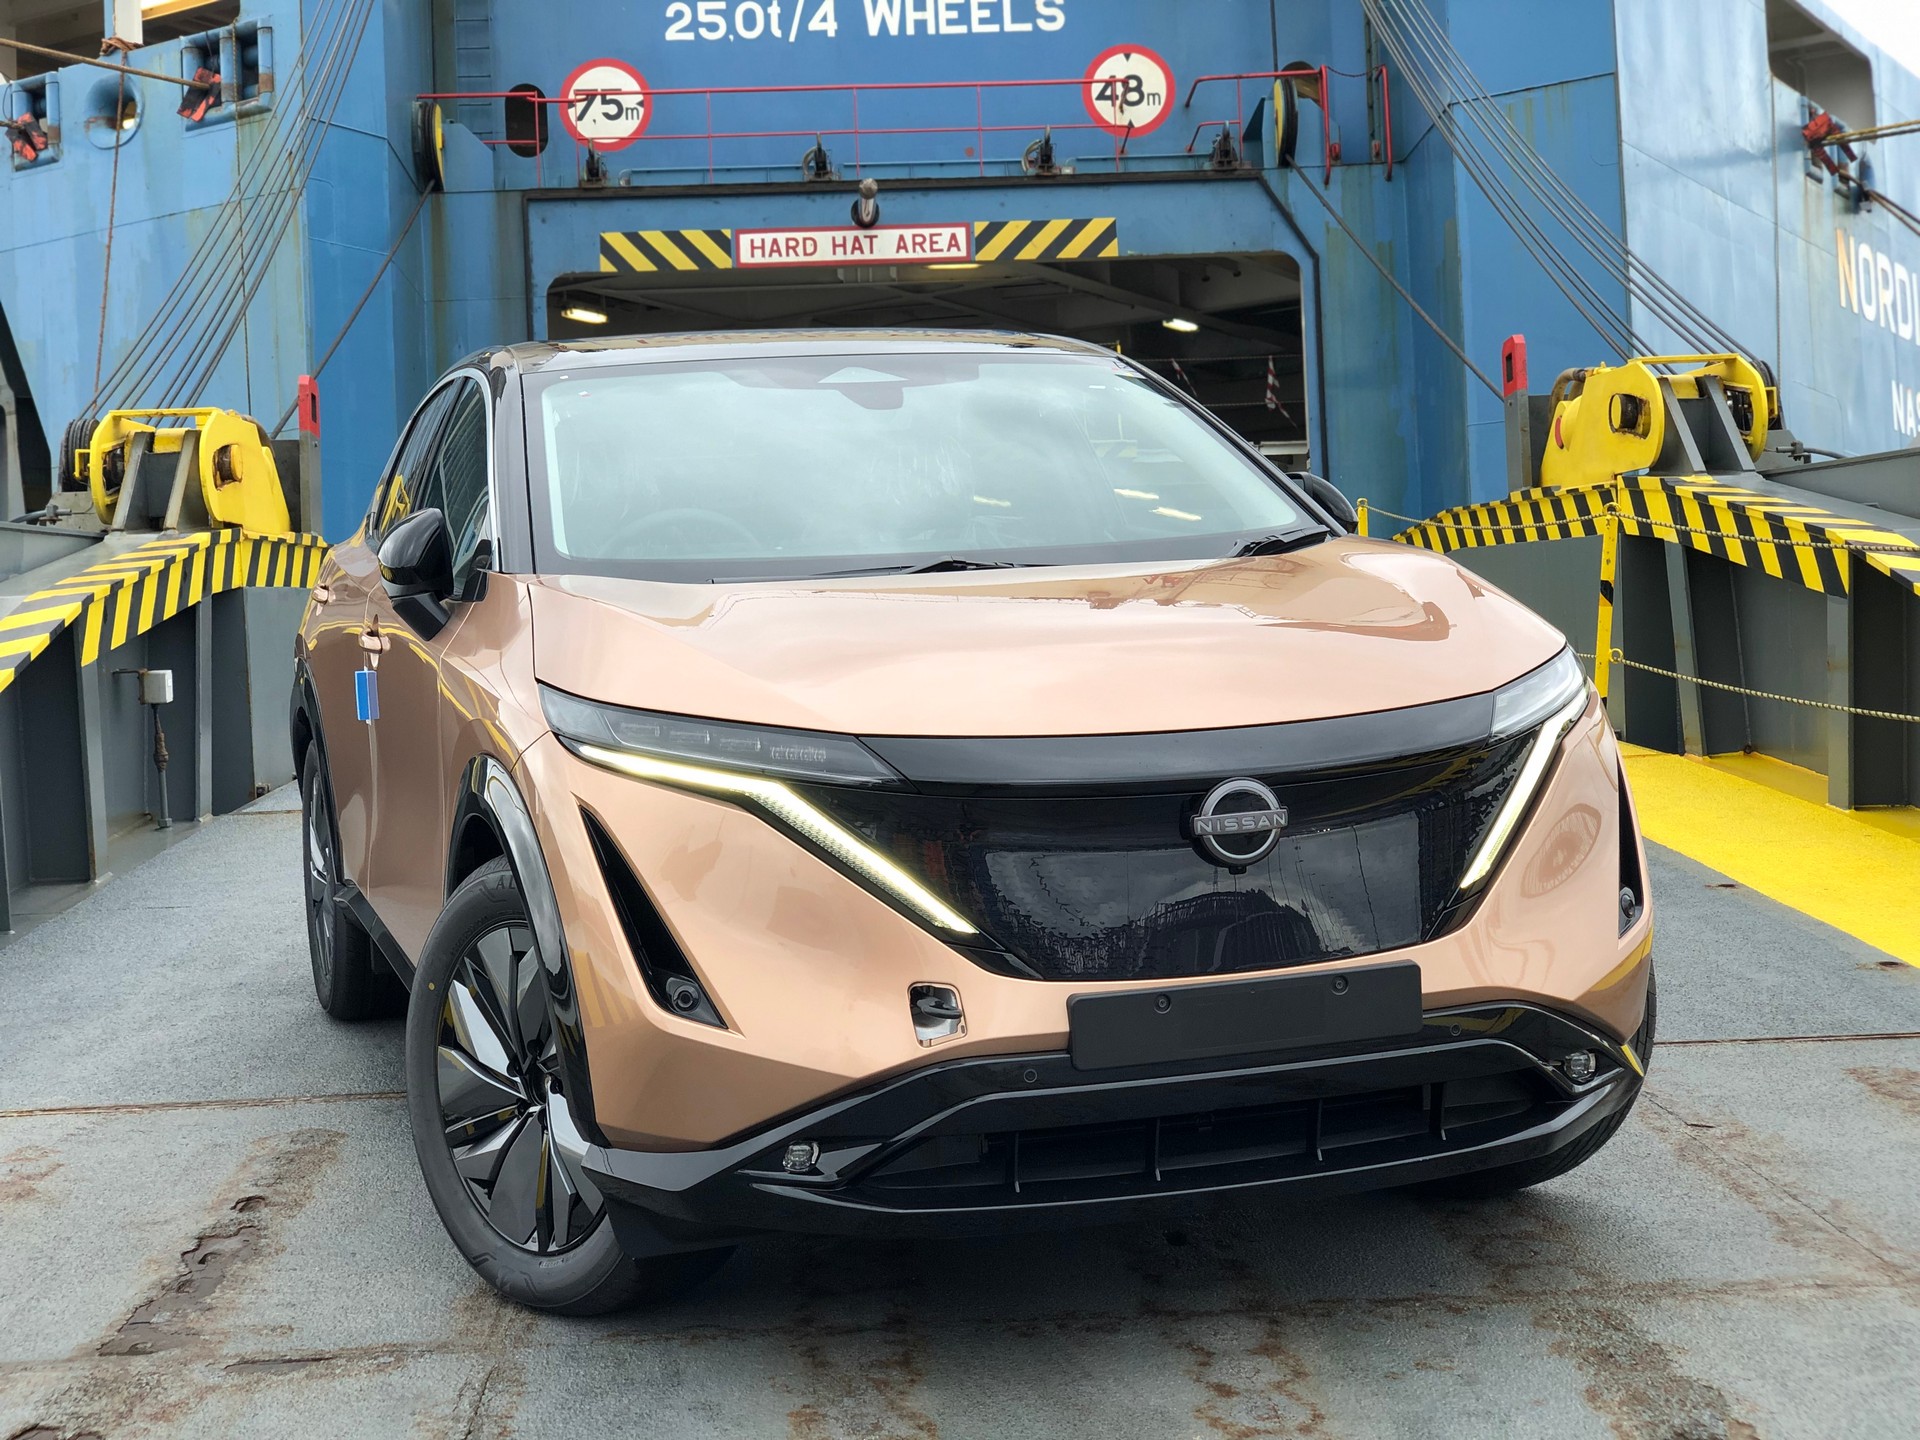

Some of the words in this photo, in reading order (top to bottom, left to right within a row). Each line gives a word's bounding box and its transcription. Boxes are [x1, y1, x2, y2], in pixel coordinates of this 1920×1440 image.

[864, 0, 1066, 36] WHEELS
[750, 237, 818, 258] HARD
[832, 235, 878, 256] HAT
[896, 233, 961, 254] AREA
[1198, 813, 1285, 833] NISSAN
